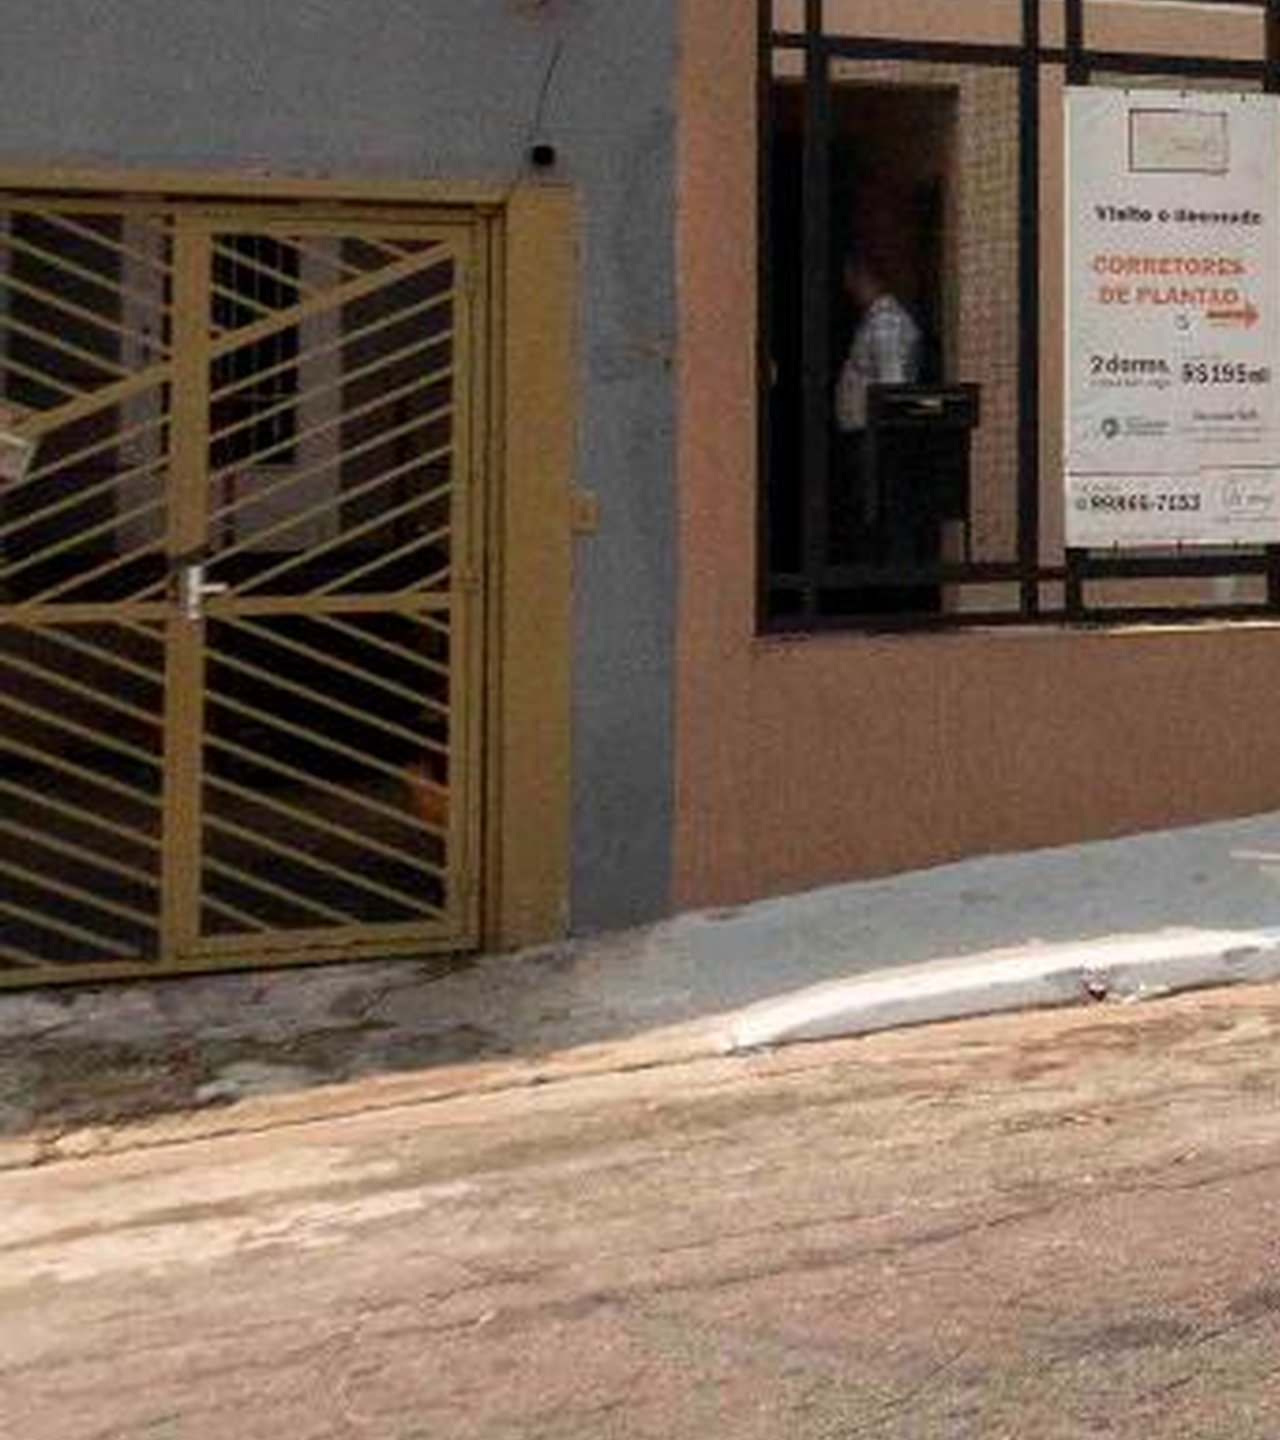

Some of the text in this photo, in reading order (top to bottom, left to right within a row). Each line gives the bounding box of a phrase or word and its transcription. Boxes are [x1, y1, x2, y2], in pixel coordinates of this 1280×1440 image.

[1093, 254, 1248, 275] CORRETORES
[1099, 286, 1130, 304] DE
[1090, 355, 1104, 374] 2
